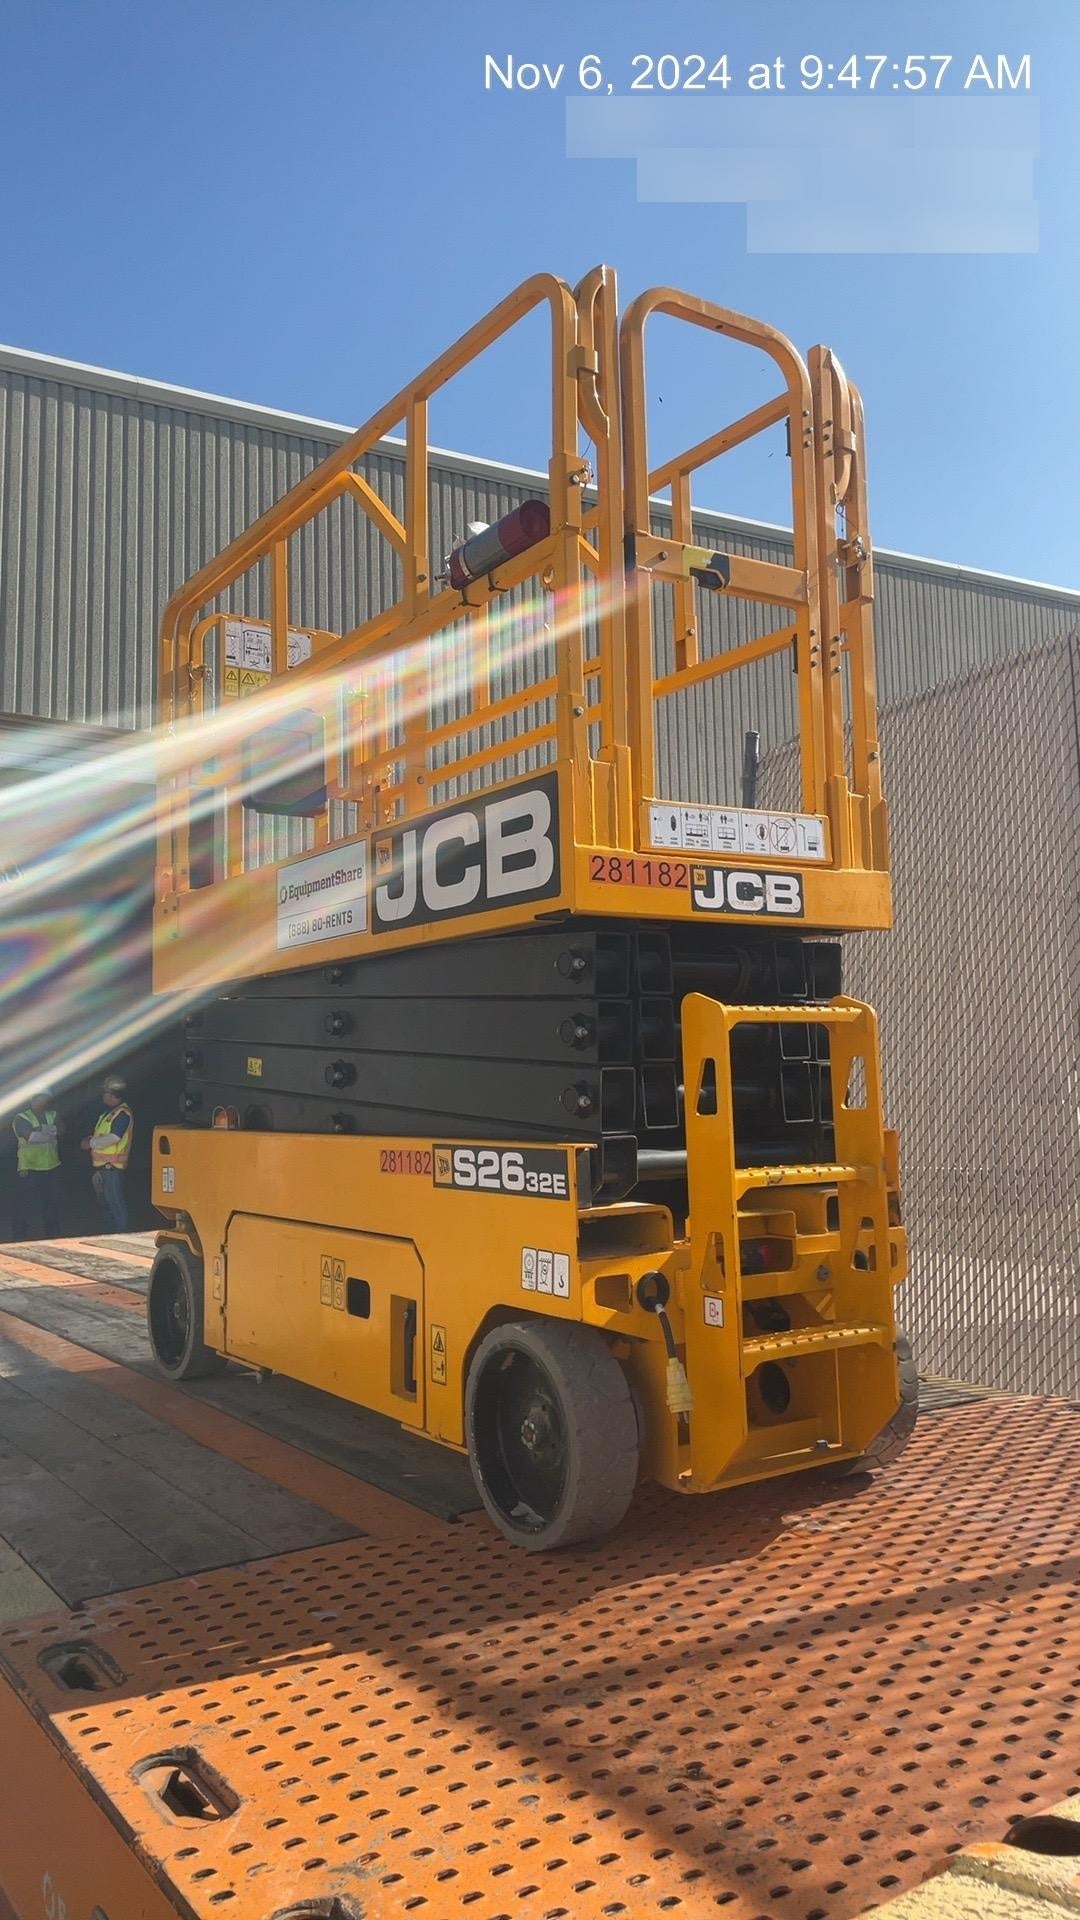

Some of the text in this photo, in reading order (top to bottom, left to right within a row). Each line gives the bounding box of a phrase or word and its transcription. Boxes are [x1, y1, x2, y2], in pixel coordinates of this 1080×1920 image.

[375, 789, 554, 923] JCB
[590, 855, 688, 889] 281182
[288, 866, 363, 901] EquipmentShare
[694, 870, 802, 914] JCB
[312, 909, 353, 932] 80-RENTS
[380, 1150, 432, 1175] 281182
